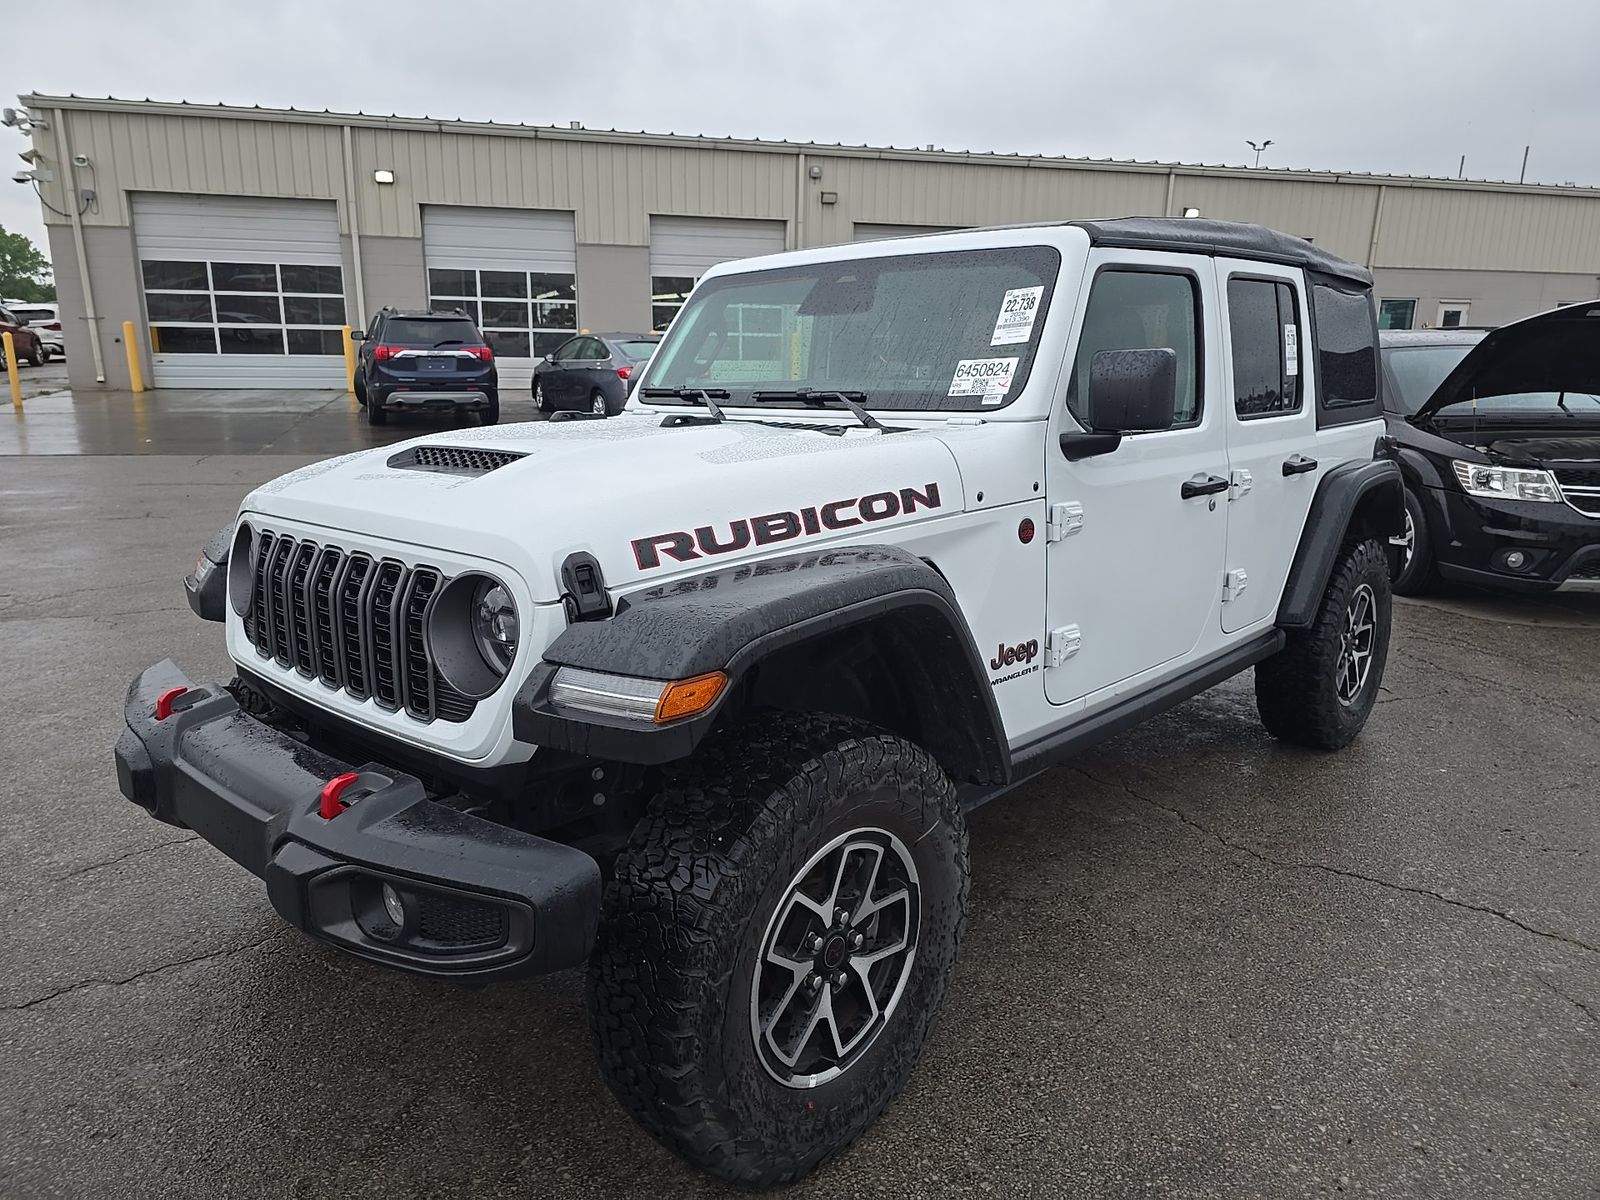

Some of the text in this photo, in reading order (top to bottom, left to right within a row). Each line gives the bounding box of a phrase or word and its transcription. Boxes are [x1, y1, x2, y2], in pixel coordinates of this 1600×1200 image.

[956, 362, 1011, 378] 6450824
[630, 482, 942, 571] RUBICON
[990, 639, 1039, 670] Jeep
